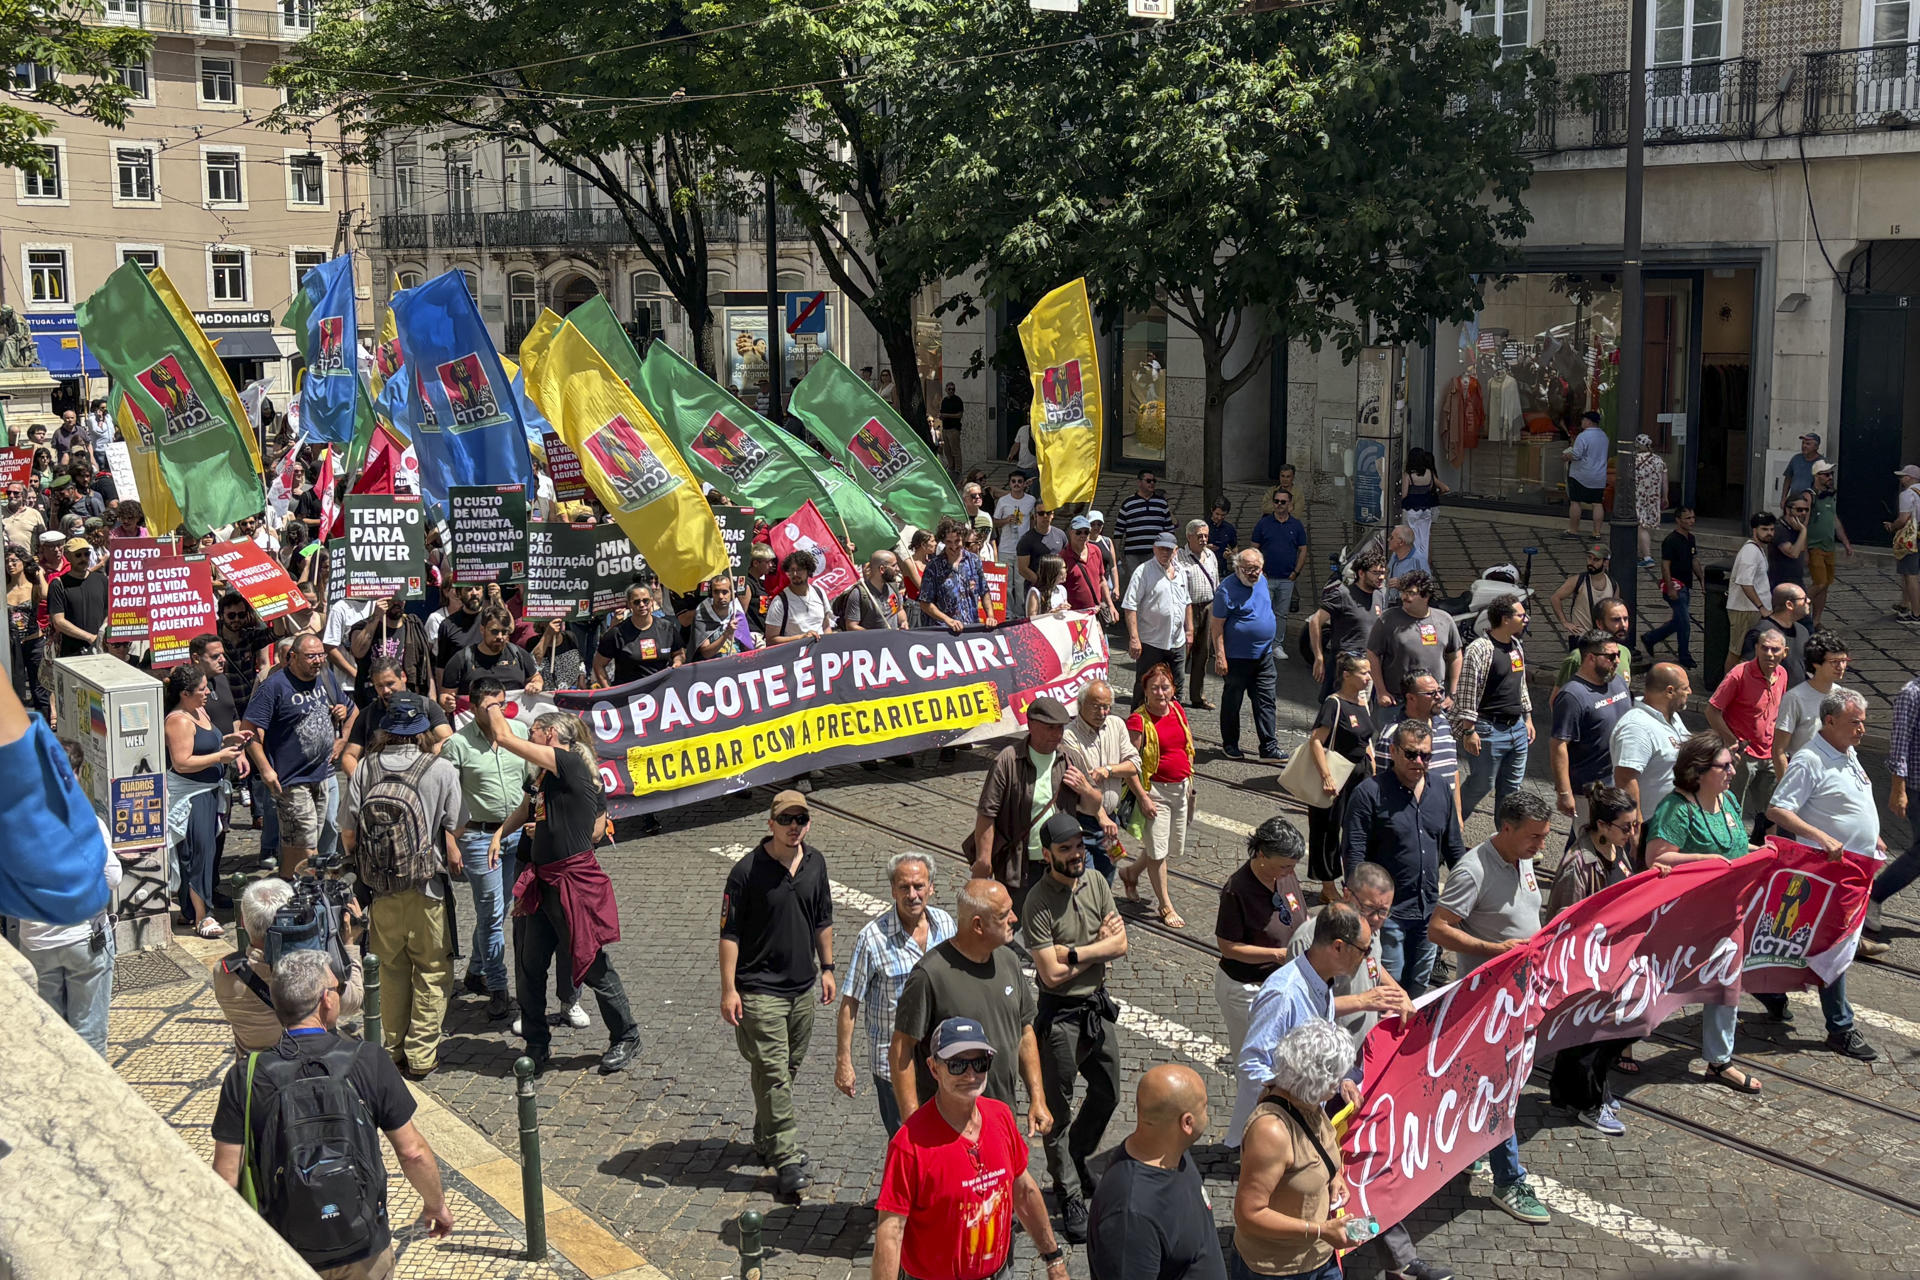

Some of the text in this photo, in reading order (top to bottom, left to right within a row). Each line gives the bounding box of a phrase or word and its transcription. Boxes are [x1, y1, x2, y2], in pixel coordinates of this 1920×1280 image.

[195, 313, 270, 324] McDonald's
[558, 462, 580, 471] POVO
[453, 496, 503, 506] O CUSTO
[349, 508, 419, 525] TEMPO
[453, 507, 499, 518] DE VIDA
[455, 518, 514, 530] AUMENTA.
[349, 526, 405, 543] PARA
[455, 529, 524, 542] O POVO NÃO
[529, 532, 552, 543] PAZ
[114, 548, 160, 559] O CUSTO
[331, 549, 338, 558] O
[350, 545, 410, 561] VIVER
[456, 541, 515, 554] AGUENTA!
[529, 542, 552, 555] PÃO
[210, 551, 243, 566] BASTA
[331, 559, 341, 569] DE
[528, 555, 594, 569] HABITAÇÃO
[597, 554, 646, 577] 050€
[113, 561, 128, 571] DE
[147, 566, 190, 580] O CUSTO
[528, 565, 567, 579] SAÚDE
[112, 586, 120, 596] O
[147, 579, 188, 593] DE VIDA
[330, 581, 337, 590] O
[528, 577, 589, 593] EDUCAÇÃO
[149, 590, 202, 606] AUMENTA.
[151, 601, 211, 619] O POVO NÃO
[152, 616, 204, 632] AGUENTA!
[591, 634, 1016, 743] O PACOTE É P'RA CAIR!
[646, 739, 744, 784] ACABAR
[752, 725, 796, 760] COM
[802, 718, 811, 746] A
[817, 689, 989, 742] PRECARIEDADE
[120, 779, 155, 793] QUADROS
[1752, 934, 1803, 958] CGTP
